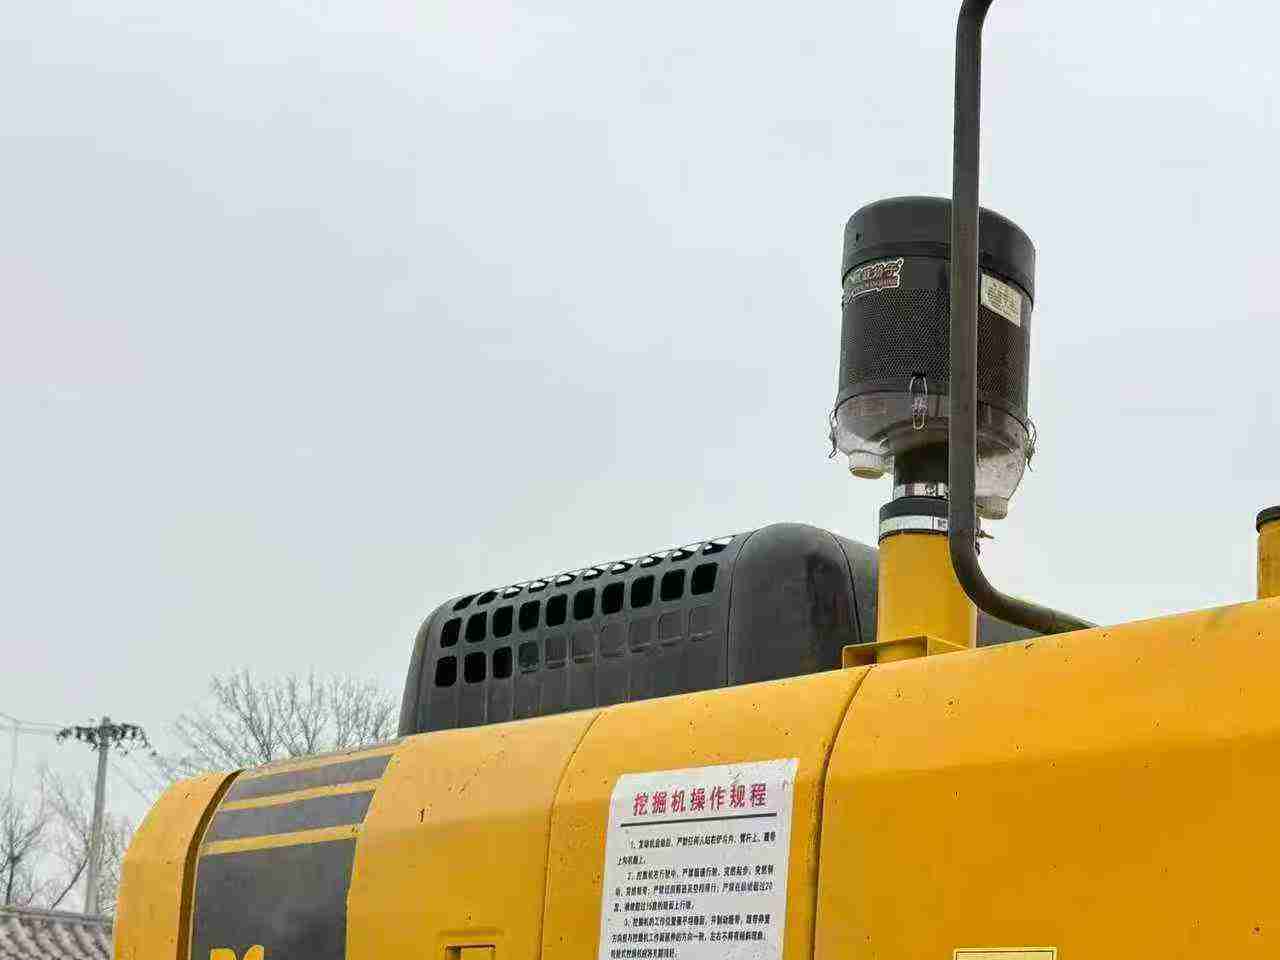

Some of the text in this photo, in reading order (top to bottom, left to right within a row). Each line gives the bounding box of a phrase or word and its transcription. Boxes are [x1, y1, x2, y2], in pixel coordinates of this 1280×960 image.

[633, 783, 768, 816] 挖掘机操作规程
